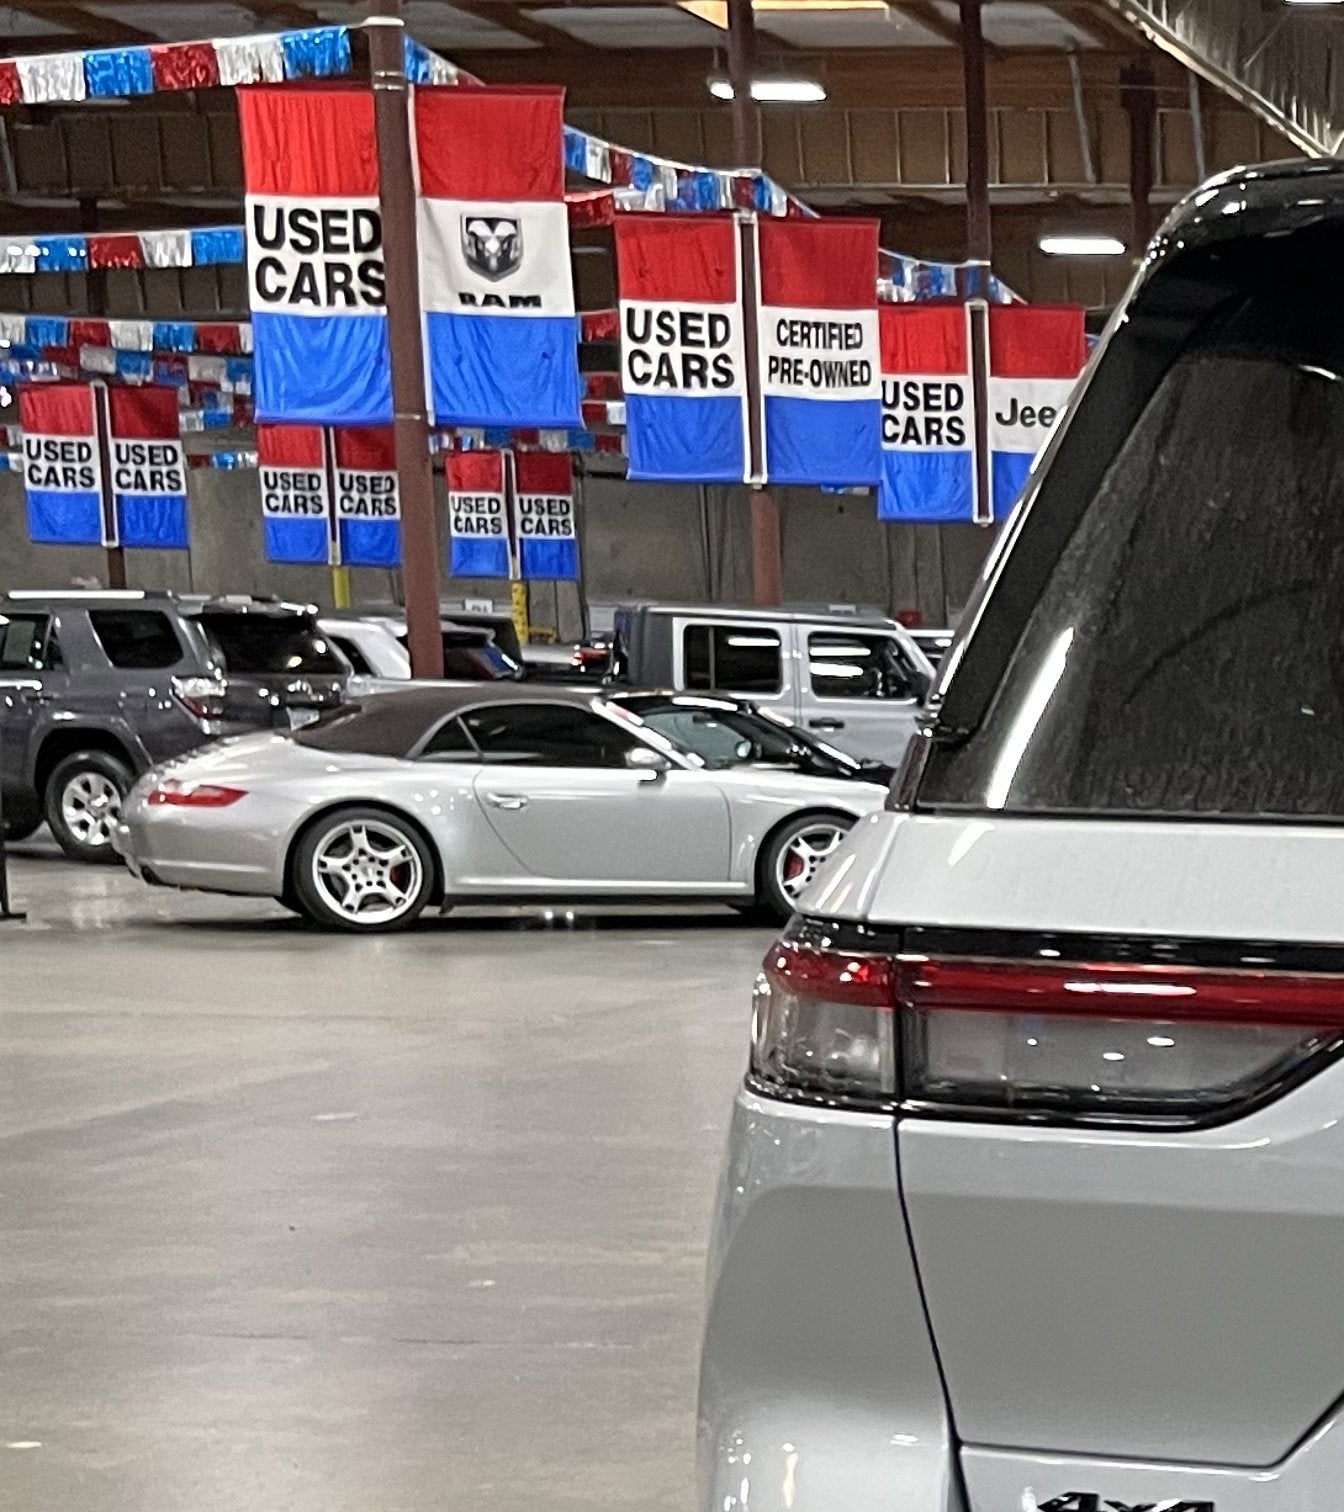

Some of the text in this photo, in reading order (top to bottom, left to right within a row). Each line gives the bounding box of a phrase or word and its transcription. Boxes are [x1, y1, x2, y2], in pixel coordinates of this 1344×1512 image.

[253, 204, 383, 255] USED
[255, 256, 386, 308] CARS
[626, 307, 731, 349] USED
[776, 318, 864, 350] CERTIFIED
[627, 349, 735, 389] CARS
[767, 355, 872, 388] PRE-OWNED
[881, 380, 965, 412] USED
[995, 397, 1057, 428] Jee
[881, 413, 966, 446] CARS
[25, 438, 92, 463] USED
[114, 442, 179, 467] USED
[27, 463, 95, 489] CARS
[115, 468, 182, 492] CARS
[263, 471, 321, 492] USED
[339, 473, 395, 494] USED
[264, 493, 323, 514] CARS
[340, 495, 397, 516] CARS
[451, 496, 501, 514] USED
[519, 497, 570, 516] USED
[453, 515, 503, 534] CARS
[520, 517, 572, 536] CARS
